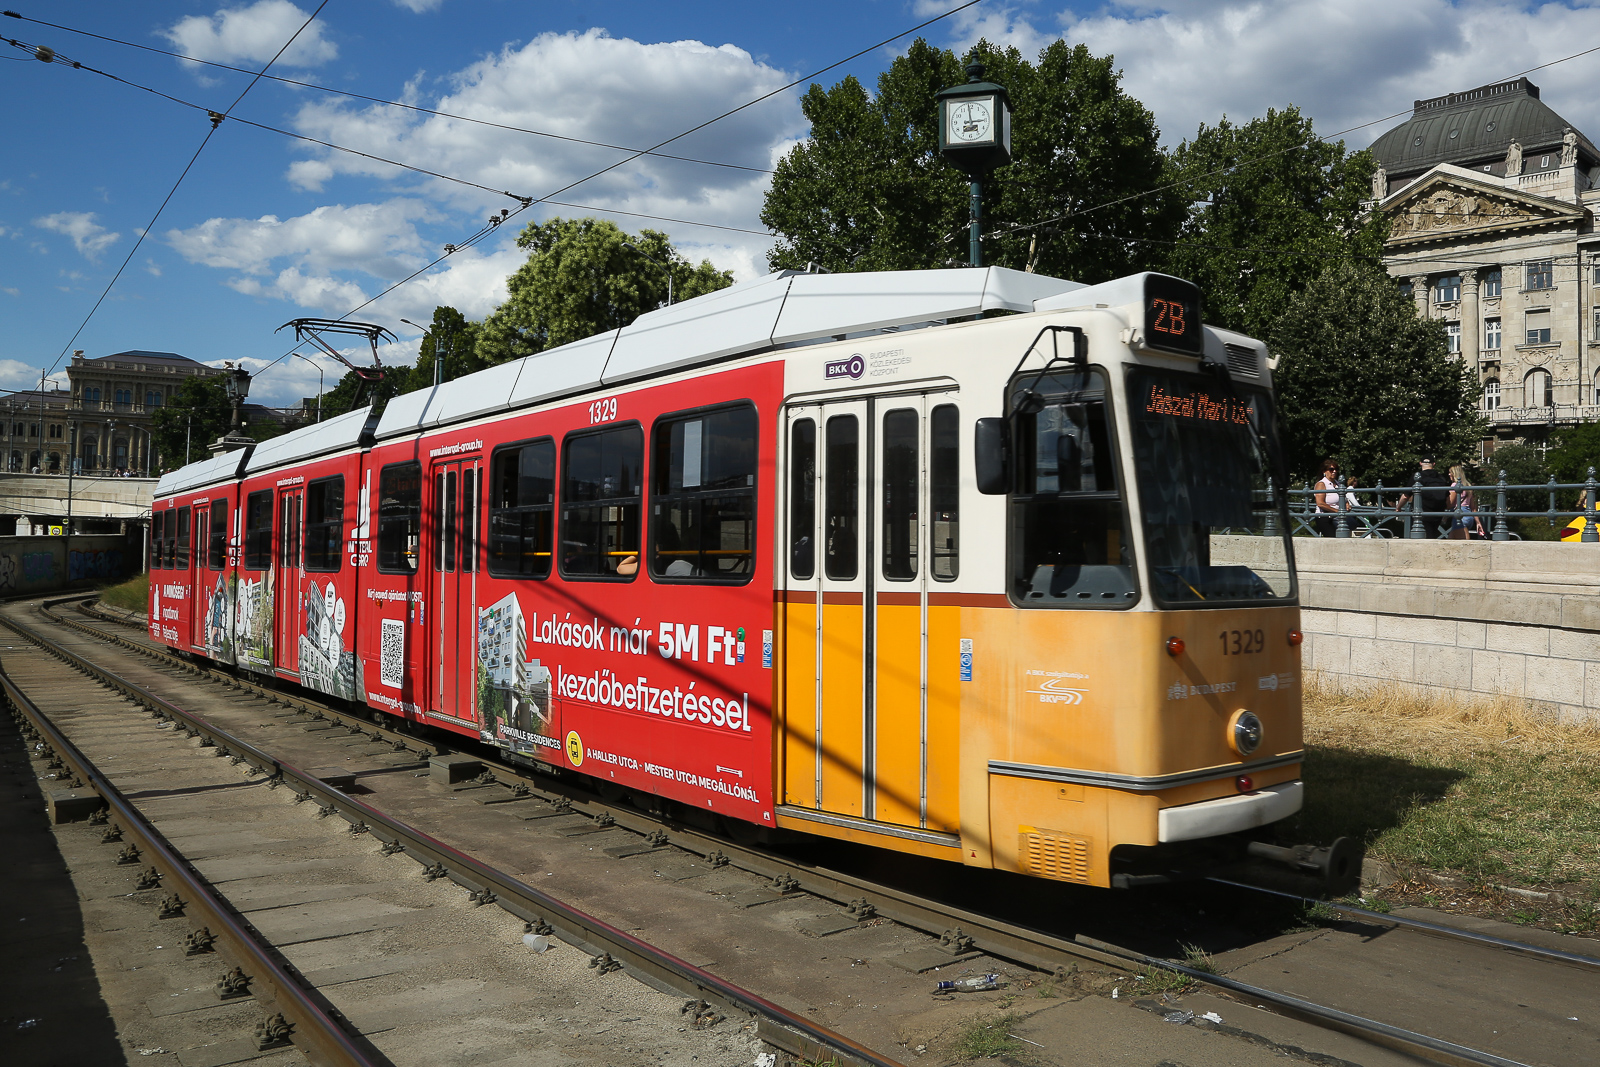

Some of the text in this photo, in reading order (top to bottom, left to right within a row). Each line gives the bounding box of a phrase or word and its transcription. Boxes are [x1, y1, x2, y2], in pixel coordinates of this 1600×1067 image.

[1153, 298, 1186, 335] 2B
[829, 364, 847, 375] BKK
[588, 397, 618, 425] 1329
[532, 612, 736, 666] Lakások már 5M Ft
[1219, 629, 1265, 656] 1329
[557, 664, 751, 732] kezdőbefizetéssel
[1190, 682, 1237, 696] BUDAPEST
[500, 724, 562, 750] PARKVILLE RESIDENCES
[586, 747, 592, 758] A
[592, 749, 618, 765] HALLER
[618, 756, 639, 771] UTCA
[644, 762, 675, 780] MESTER
[675, 769, 698, 786] UTCA
[698, 777, 760, 804] MEGÁLLÓNÁL
